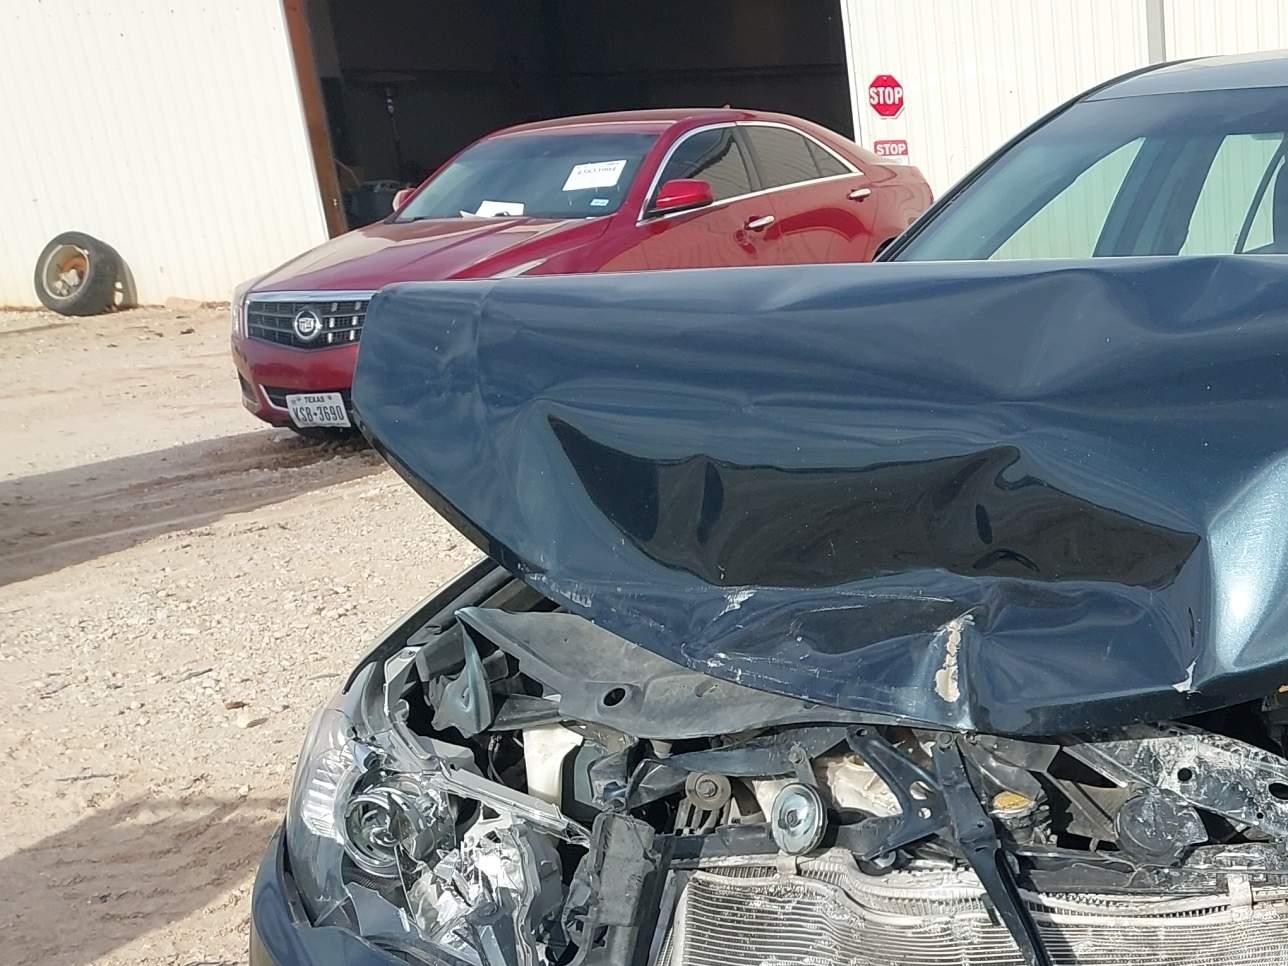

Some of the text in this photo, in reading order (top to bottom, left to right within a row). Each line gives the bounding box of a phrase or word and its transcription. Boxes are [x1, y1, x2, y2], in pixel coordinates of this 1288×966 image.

[869, 86, 903, 105] STOP
[876, 143, 906, 155] STOP
[304, 395, 325, 403] TEXAS
